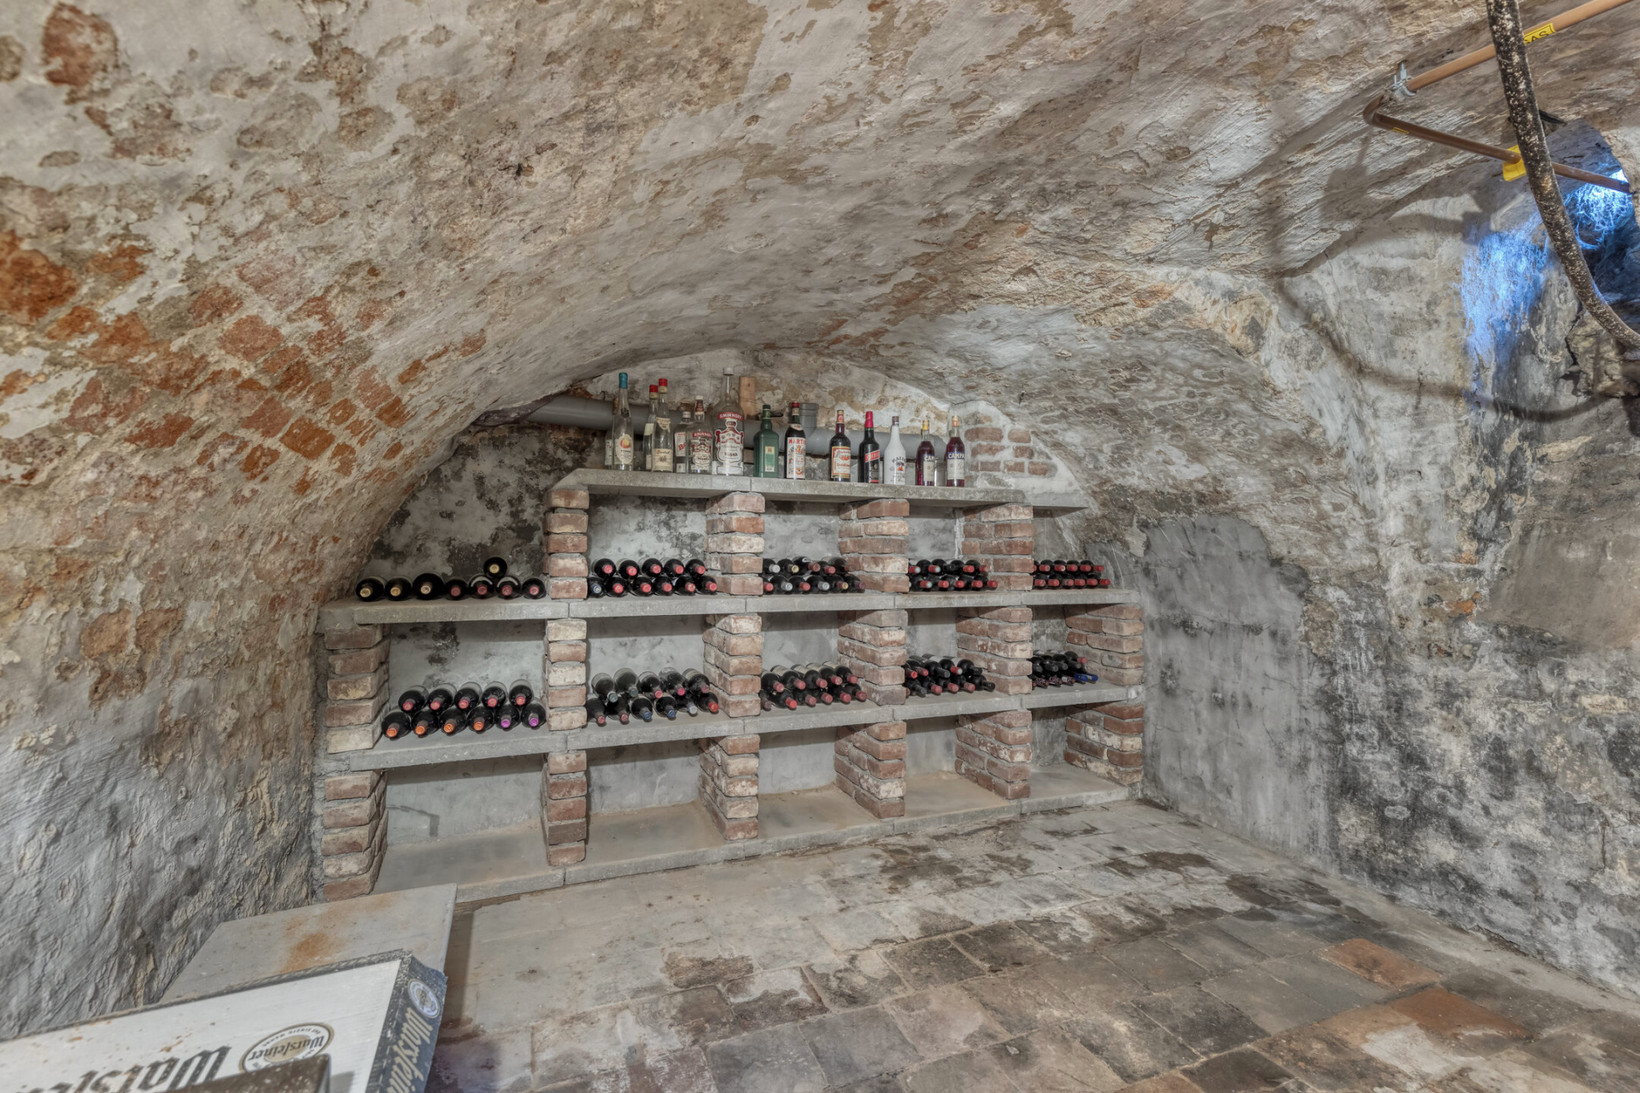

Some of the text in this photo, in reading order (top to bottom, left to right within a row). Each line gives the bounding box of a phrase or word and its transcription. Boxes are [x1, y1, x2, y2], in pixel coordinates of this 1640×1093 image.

[1523, 30, 1550, 44] AS
[247, 1035, 325, 1062] Warsteiner
[386, 1007, 433, 1093] Warstein
